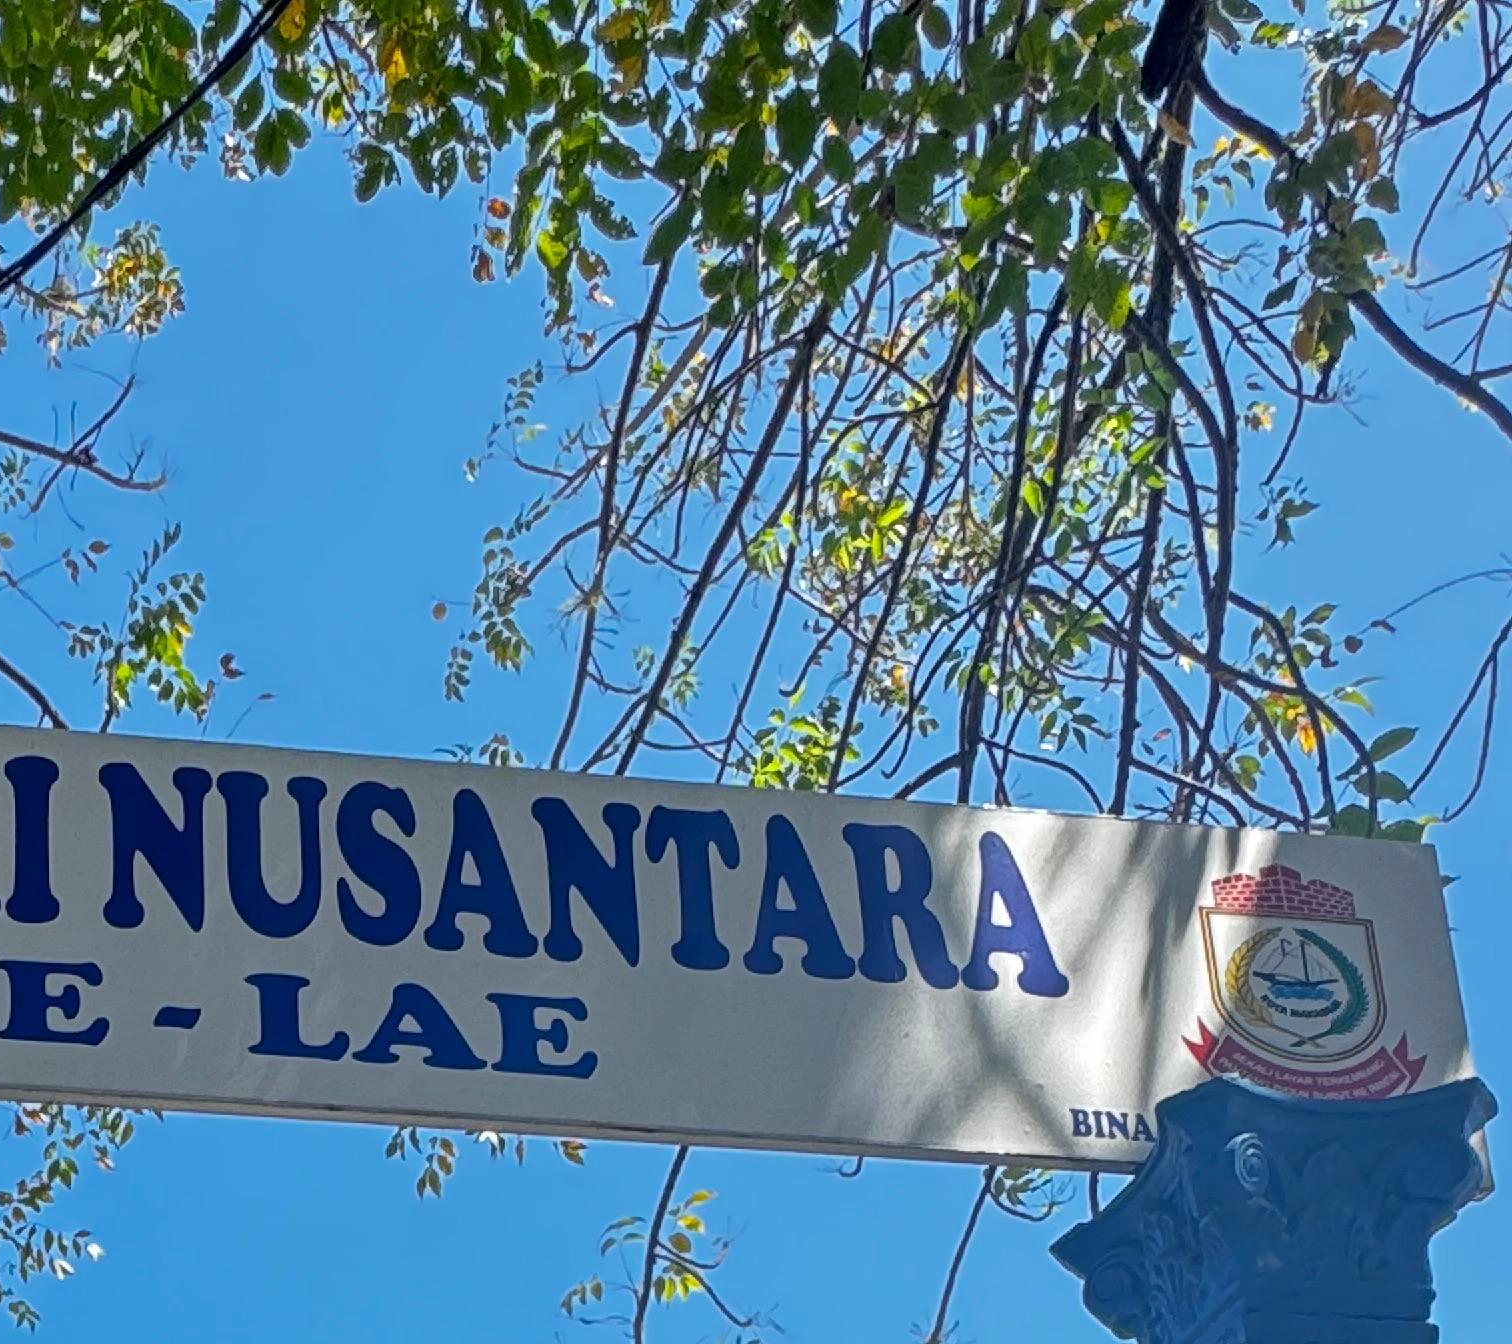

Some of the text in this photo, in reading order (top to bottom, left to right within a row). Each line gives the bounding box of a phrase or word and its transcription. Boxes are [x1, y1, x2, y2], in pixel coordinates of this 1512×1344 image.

[98, 761, 1070, 998] NUSANTARA
[245, 972, 599, 1080] LAE
[1068, 1108, 1157, 1143] BINA
